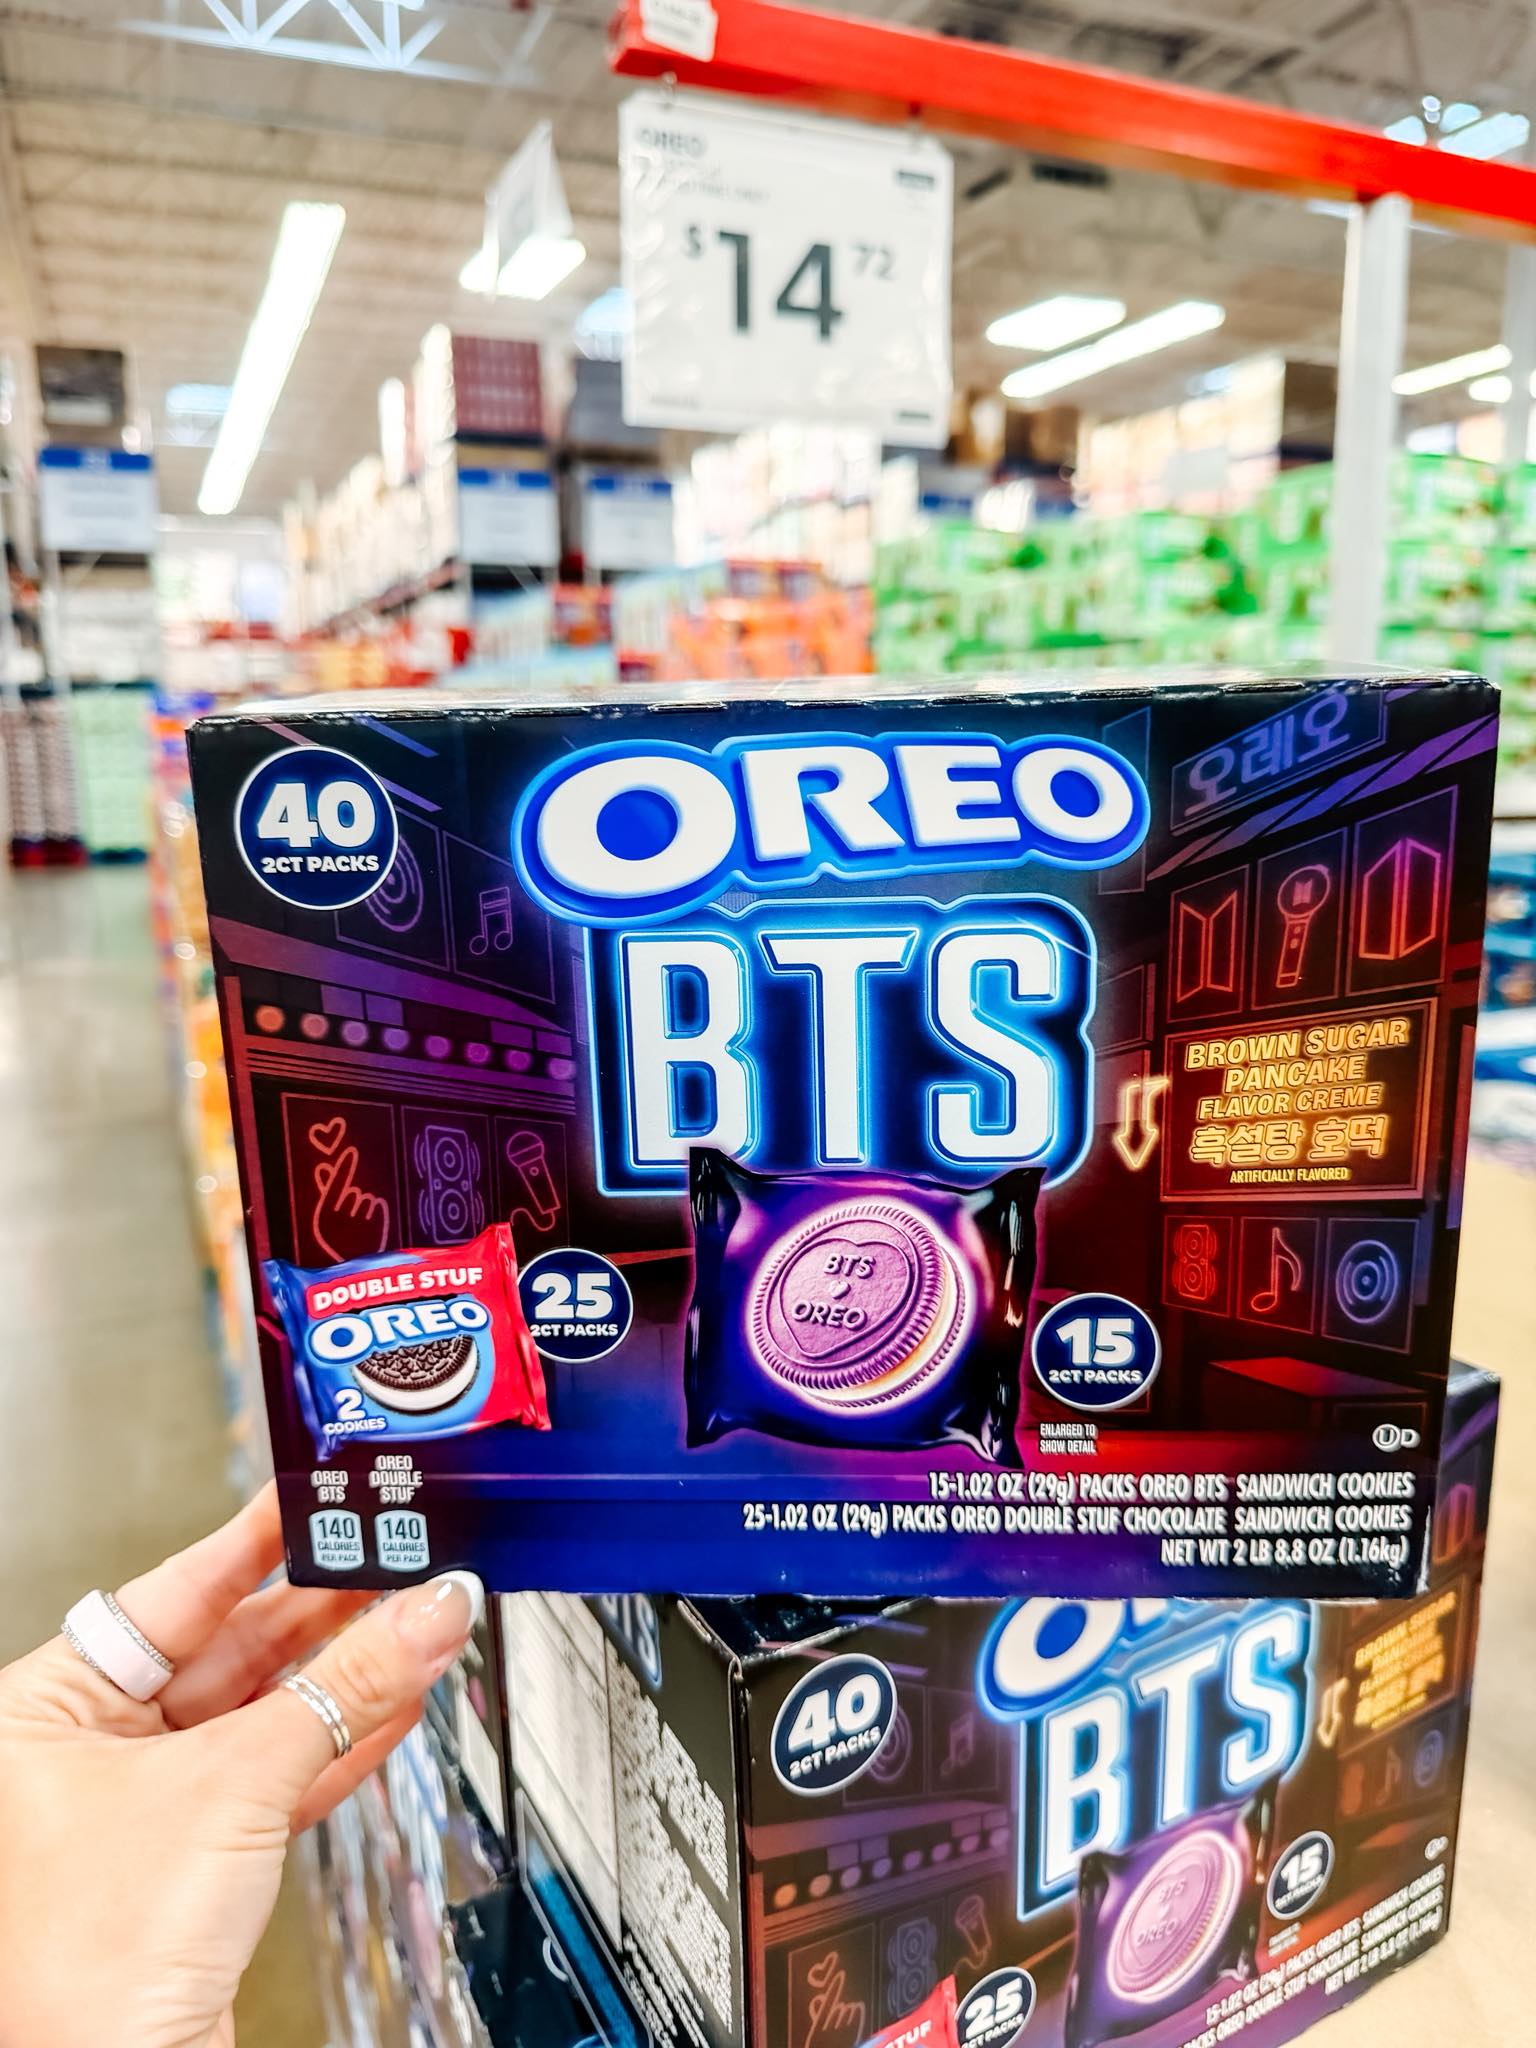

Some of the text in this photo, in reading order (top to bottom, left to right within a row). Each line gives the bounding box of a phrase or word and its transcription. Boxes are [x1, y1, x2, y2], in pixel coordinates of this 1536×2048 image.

[1184, 693, 1350, 817] 오레오
[257, 780, 376, 848] 40
[537, 745, 1134, 899] OREO
[261, 855, 380, 874] 2CT PACKS
[619, 926, 1060, 1168] BTS
[1186, 1018, 1410, 1070] BROWN SUGAR
[1224, 1053, 1367, 1093] PANCAKE
[1198, 1083, 1383, 1121] FLAVOR CREME
[1191, 1115, 1387, 1165] 흑설탕 호떡
[1230, 1167, 1350, 1183] ARTIFICIALLY FLAVORED
[824, 1252, 876, 1279] BTS
[313, 1267, 484, 1313] DOUBLE STUF
[532, 1272, 614, 1320] 25
[311, 1299, 488, 1361] OREO
[530, 1323, 619, 1338] 2CT PACKS
[791, 1300, 868, 1332] OREO
[1056, 1317, 1136, 1367] 15
[1048, 1369, 1144, 1385] 2CT PACKS
[334, 1388, 366, 1422] 2
[323, 1416, 387, 1436] COOKIES
[1040, 1423, 1098, 1439] ENLARGED TO
[375, 1455, 414, 1470] OREO
[1039, 1440, 1097, 1456] SHOW DETAIL
[310, 1470, 349, 1488] OREO
[317, 1486, 346, 1503] BTS
[368, 1470, 423, 1488] DOUBLE
[379, 1486, 415, 1504] STUF
[929, 1471, 1416, 1505] 15-1.02 OZ (29g) PACKS OREO BTS SANDWICH COOKIES
[318, 1516, 356, 1540] 140
[383, 1517, 421, 1540] 140
[743, 1502, 1413, 1539] 25-1.02 OZ (29g) PACKS OREO DOUBLE STUF CHOCOLATE SANDWICH COOKIES
[317, 1541, 361, 1552] CALORIES
[382, 1541, 426, 1552] CALORIES
[404, 1554, 424, 1563] PACK
[1161, 1535, 1410, 1568] NET WT 2 LB 8.8 OZ (1.16kg)
[787, 1673, 882, 1753] 40
[789, 1725, 883, 1780] 2CT PACKS
[1044, 1609, 1299, 1887] BTS
[1280, 1842, 1323, 1891] 15
[965, 1976, 1024, 2040] 25
[984, 2013, 1026, 2042] PACKS
